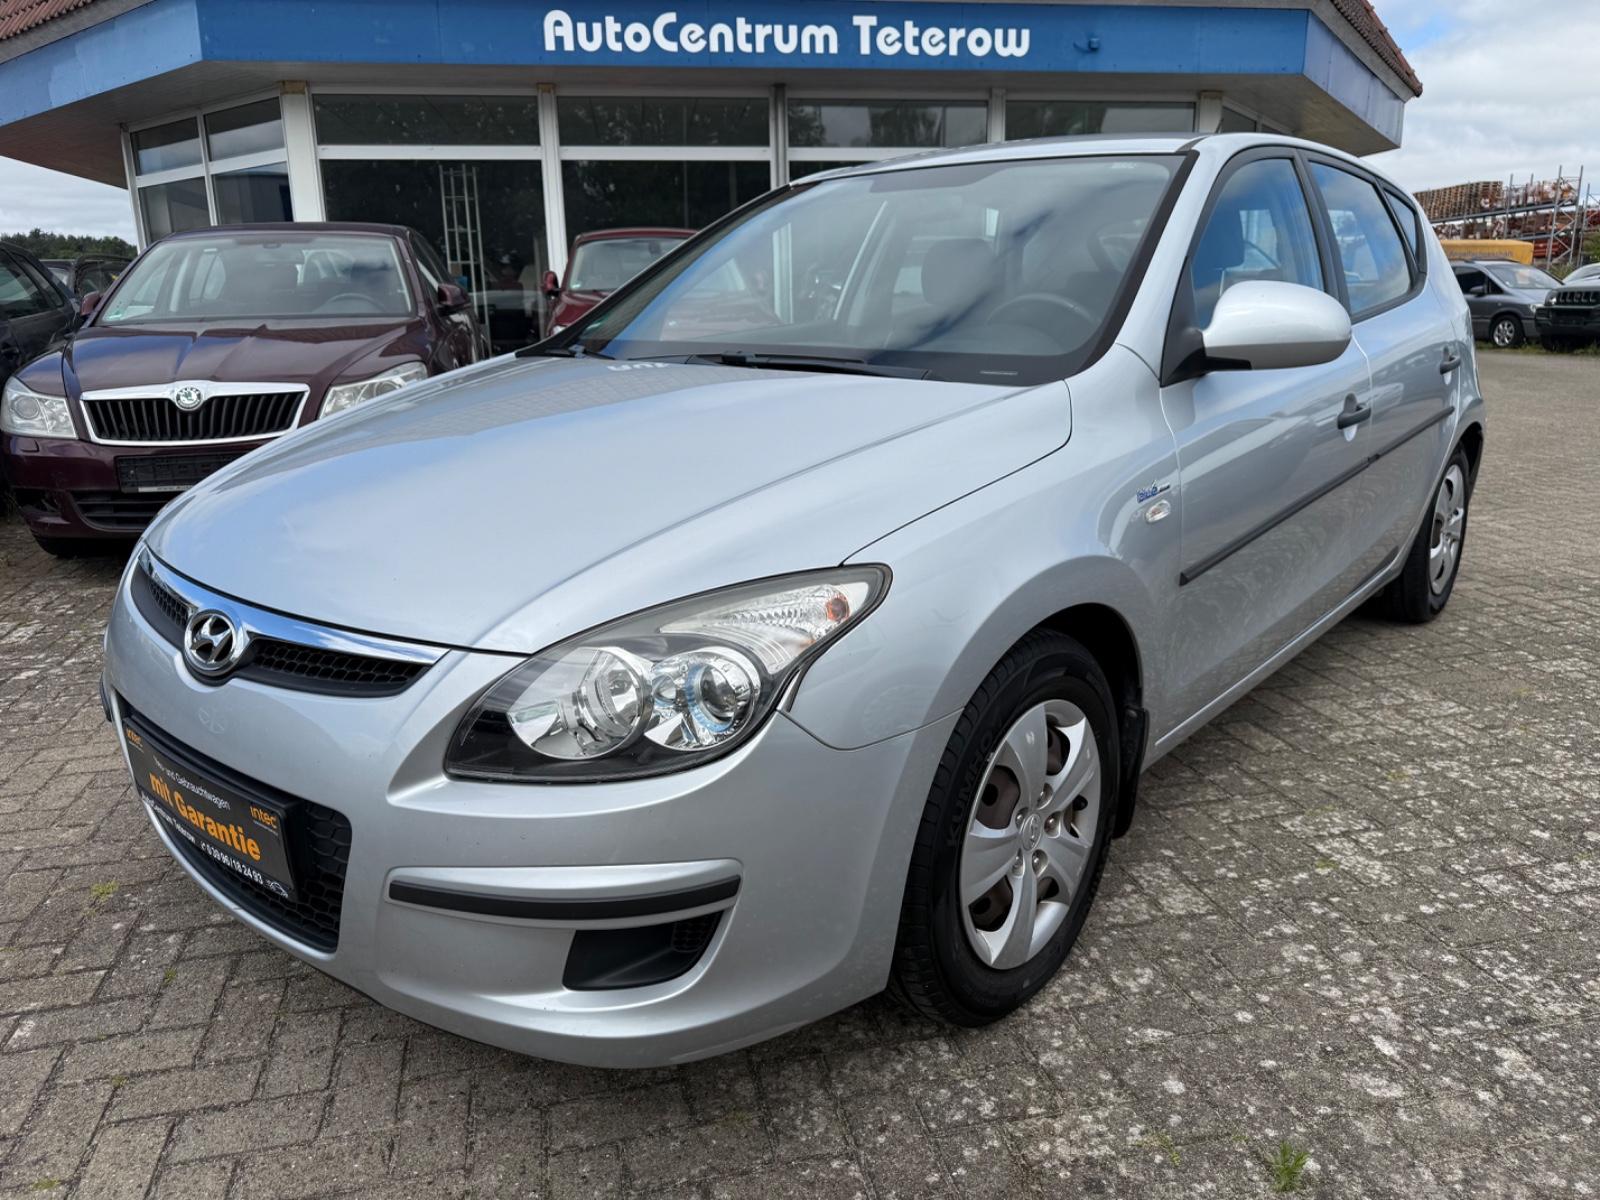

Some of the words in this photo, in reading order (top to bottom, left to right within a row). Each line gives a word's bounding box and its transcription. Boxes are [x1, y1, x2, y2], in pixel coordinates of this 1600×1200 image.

[543, 9, 838, 54] AutoCentrum
[852, 15, 1031, 58] Teterow
[149, 772, 174, 808] mit
[173, 791, 261, 861] Garantie
[249, 805, 278, 830] intec
